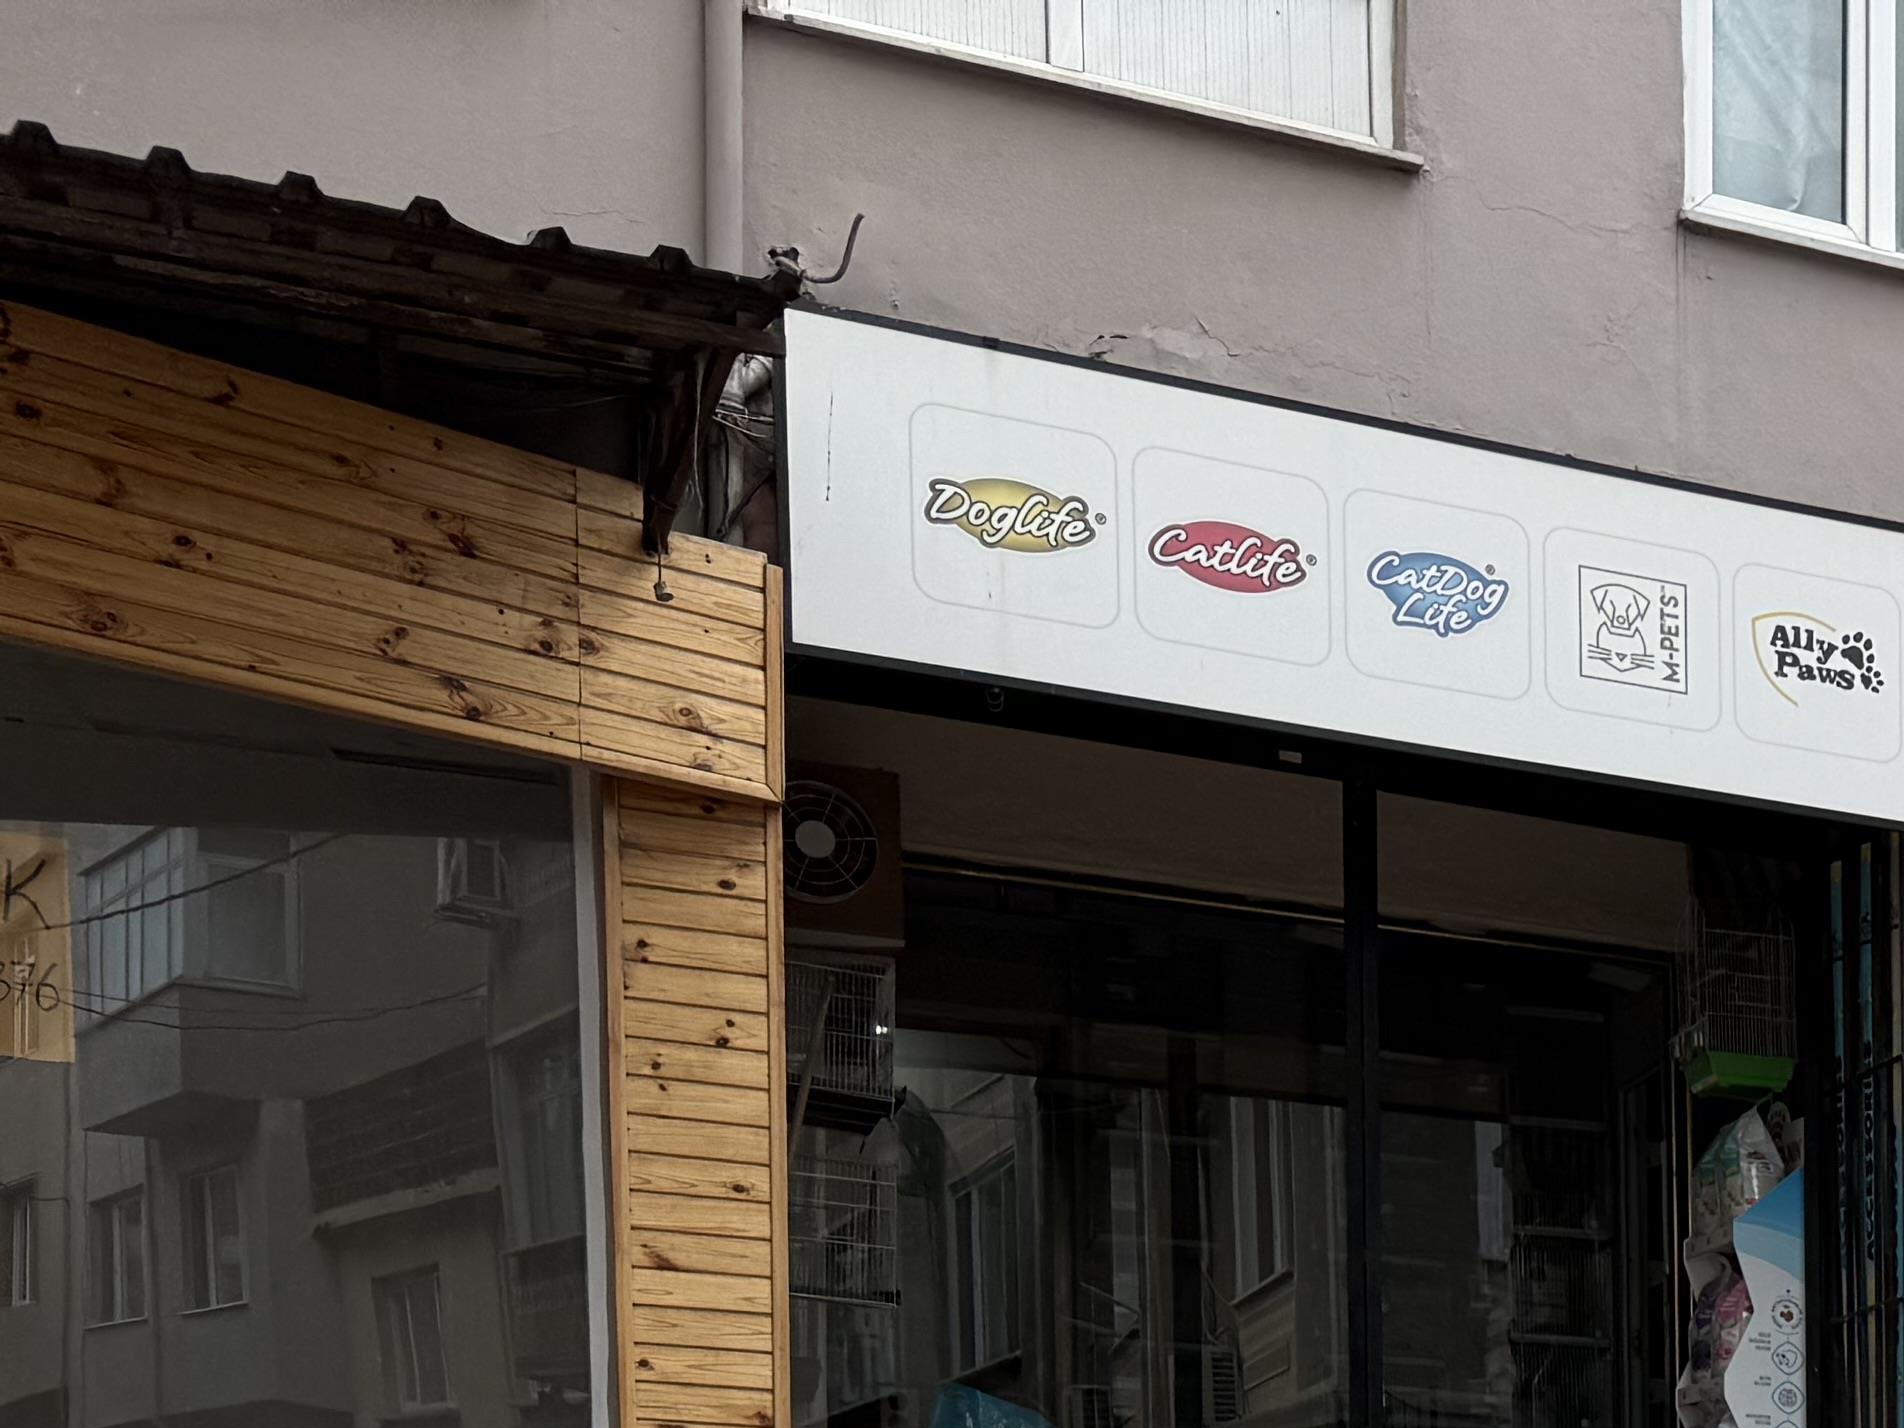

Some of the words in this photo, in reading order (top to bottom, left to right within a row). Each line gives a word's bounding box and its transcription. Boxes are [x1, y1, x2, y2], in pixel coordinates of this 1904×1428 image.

[1398, 592, 1472, 634] Life
[1659, 594, 1681, 683] M-PETS
[1769, 624, 1839, 665] Ally
[1774, 650, 1856, 690] Paws
